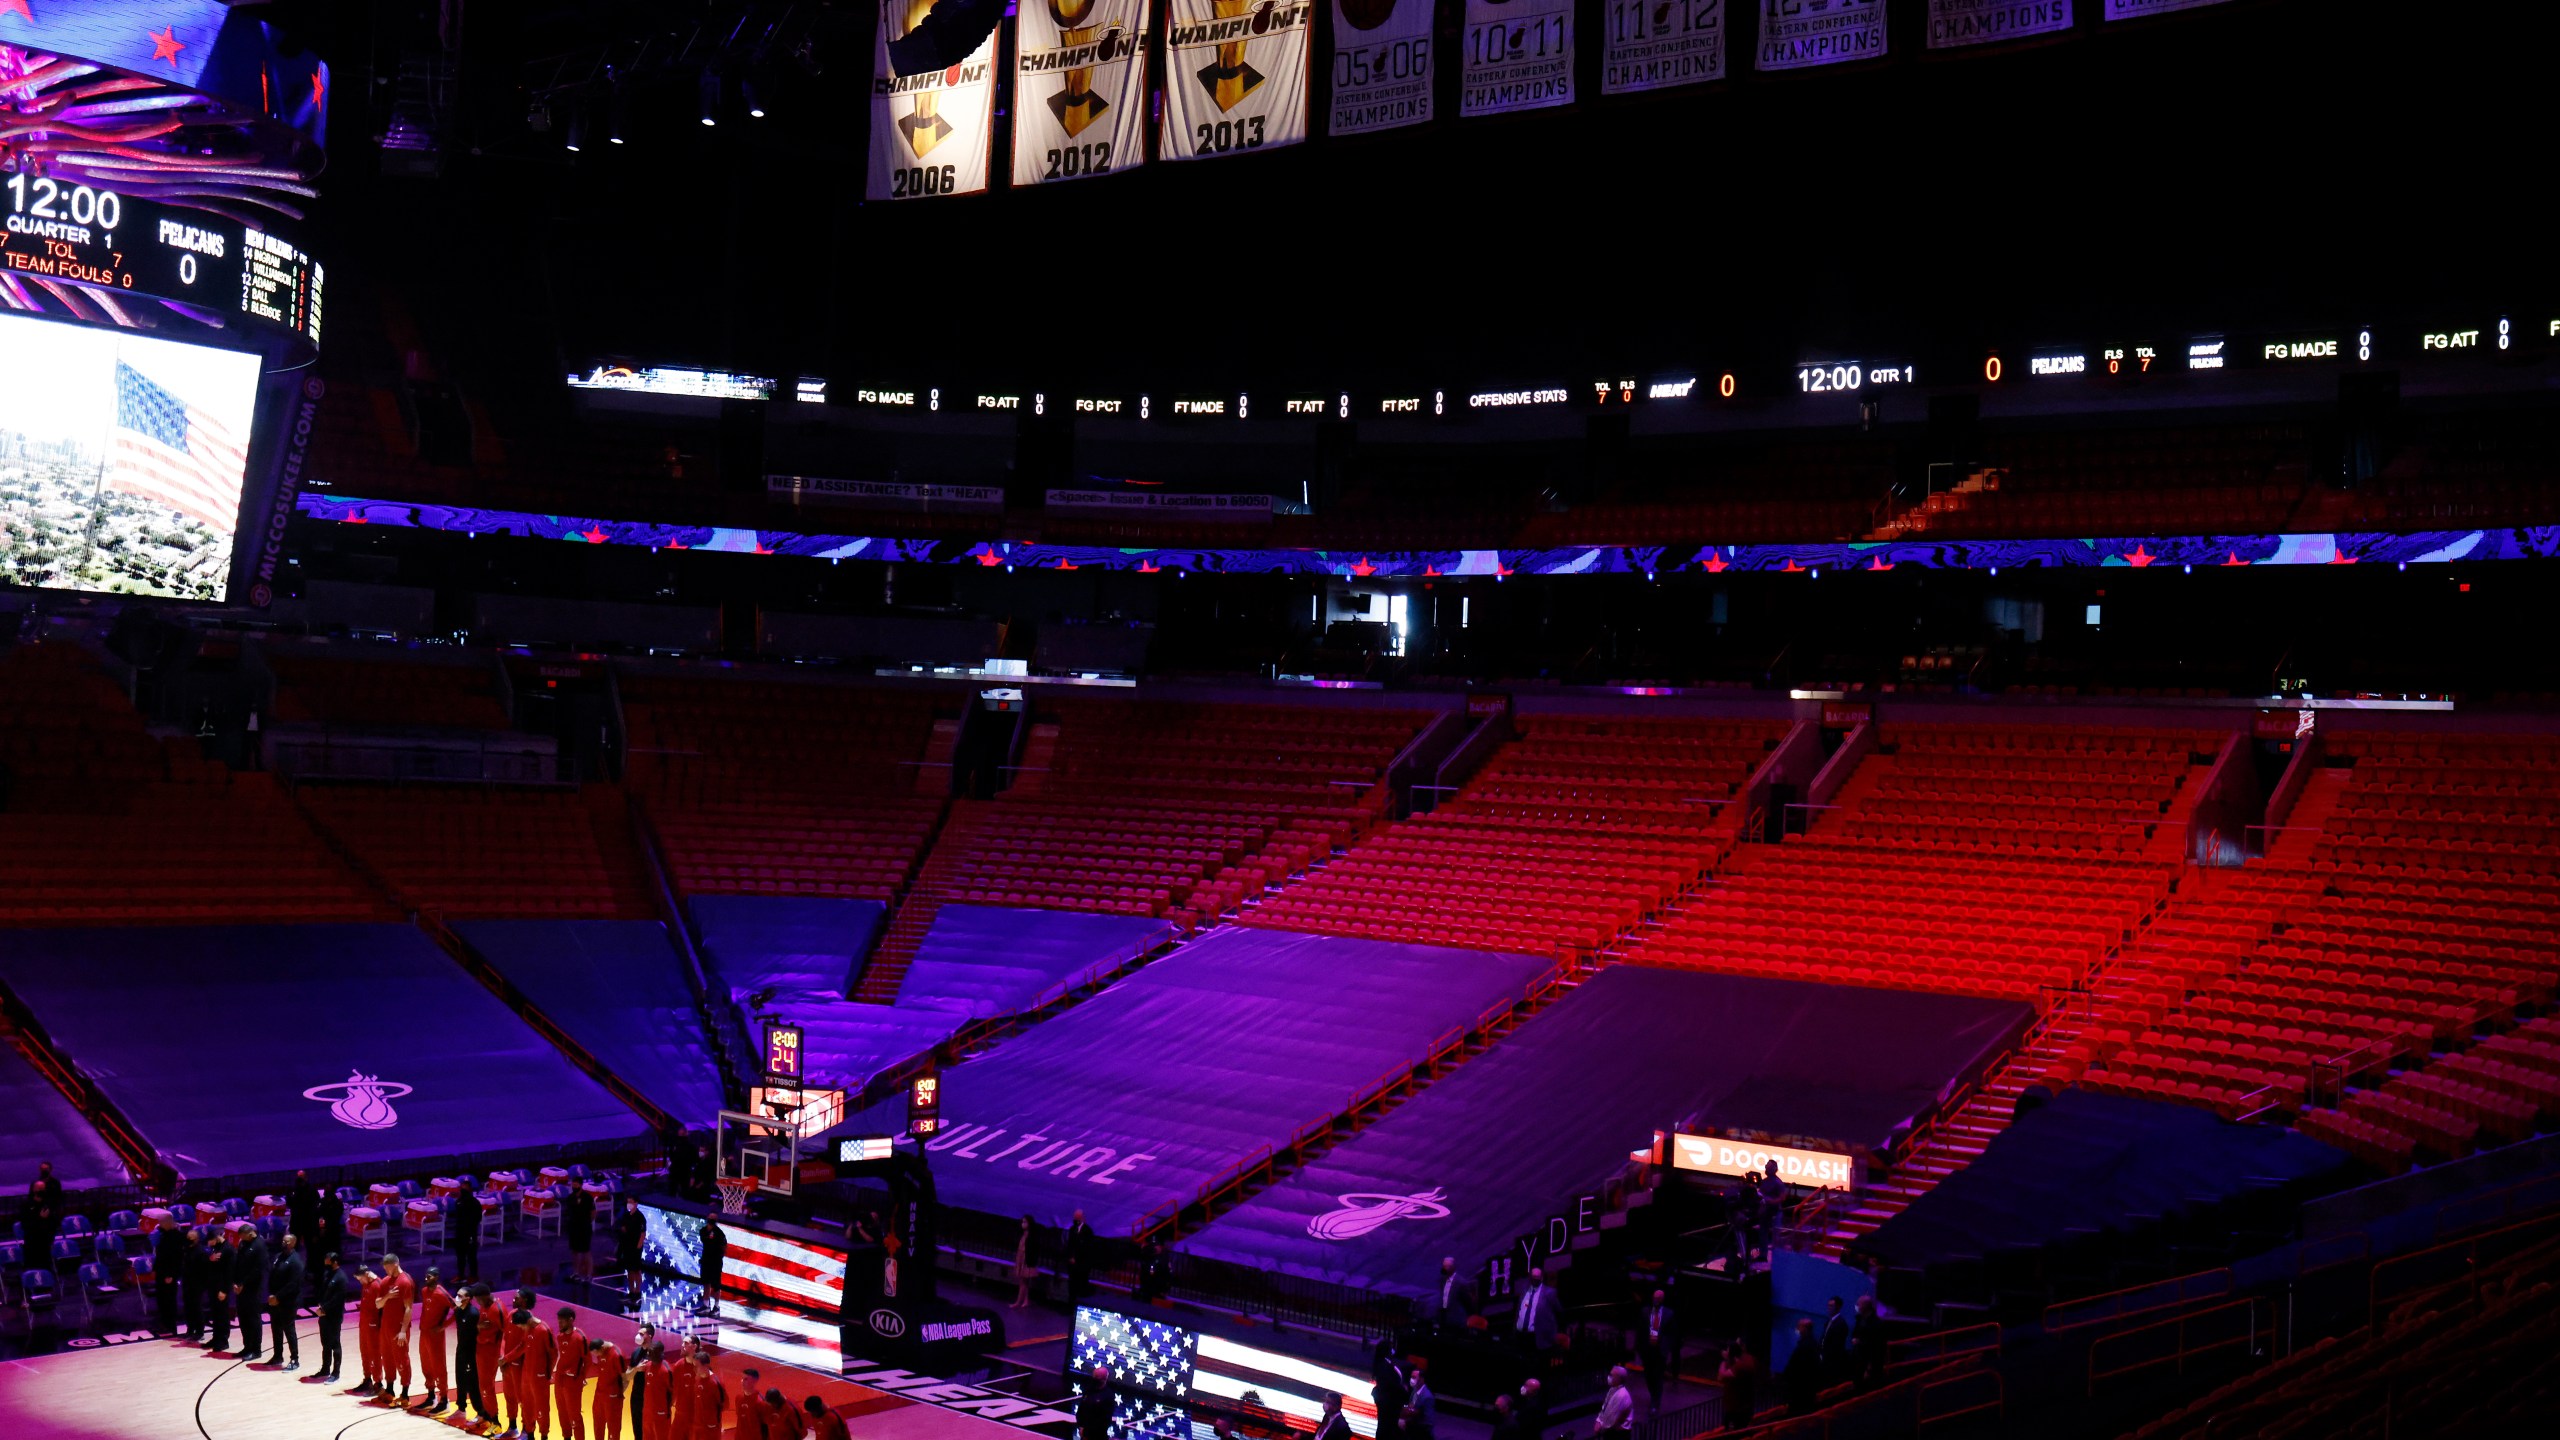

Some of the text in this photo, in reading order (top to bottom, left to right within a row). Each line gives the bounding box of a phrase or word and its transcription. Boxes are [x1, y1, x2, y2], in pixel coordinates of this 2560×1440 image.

[1934, 1, 2064, 39] CHAMPIONS
[1471, 16, 1564, 65] 10 11
[1610, 36, 1719, 60] EASTERN CONFERENCE
[1763, 28, 1881, 62] CHAMPIONS
[1336, 38, 1429, 88] 05 06
[1466, 60, 1567, 83] EASTERN CONFERENCE
[1608, 53, 1718, 85] CHAMPIONS
[1466, 77, 1568, 107] CHAMPIONS
[1336, 98, 1428, 128] CHAMPIONS
[1196, 115, 1266, 155] 2013
[1044, 142, 1111, 180] 2012
[892, 164, 956, 197] 2006
[7, 173, 120, 229] 12:00
[7, 215, 112, 249] QUARTER 1
[159, 218, 225, 257] PELICANS
[45, 240, 77, 260] TOL
[112, 253, 122, 268] 7
[243, 246, 253, 260] 14
[253, 248, 281, 269] INGRAM
[6, 252, 132, 288] TEAM FOULS 0
[179, 253, 197, 285] 0
[242, 272, 252, 287] 12
[252, 275, 277, 293] ADAMS
[243, 285, 249, 299] 2
[251, 287, 270, 304] BALL
[242, 298, 248, 311] 5
[251, 300, 282, 322] BLEDSOE
[2499, 319, 2509, 334] 0
[2360, 332, 2370, 346] 0
[2424, 330, 2479, 350] FG ATT
[2499, 335, 2509, 349] 0
[2105, 347, 2156, 360] FLS TOL
[2265, 341, 2337, 359] FG MADE
[2360, 346, 2370, 360] 0
[1986, 357, 2001, 381] 0
[2031, 355, 2085, 374] PELICANS
[2109, 358, 2150, 373] 0 7
[1595, 380, 1635, 392] TOL FLS
[1721, 374, 1735, 397] 0
[1798, 365, 1913, 391] 12:00 QTR 1
[858, 390, 914, 405] FG MADE
[930, 388, 938, 400] 0
[1435, 391, 1443, 403] 0
[1598, 390, 1631, 404] 7 0
[1650, 378, 1696, 398] HEAT
[930, 400, 938, 411] 0
[978, 396, 1019, 409] FG ATT
[1076, 400, 1121, 412] FG PCT
[1141, 397, 1149, 408] 0
[1174, 401, 1224, 413] FT MADE
[1239, 395, 1247, 406] 0
[1287, 401, 1324, 412] FT ATT
[1340, 395, 1348, 406] 0
[1382, 399, 1420, 412] FT PCT
[1469, 389, 1567, 407] OFFENSIVE STATS
[1035, 403, 1043, 415] 0
[1141, 408, 1149, 419] 0
[1239, 407, 1247, 418] 0
[1340, 406, 1348, 418] 0
[1435, 403, 1443, 415] 0
[258, 402, 317, 582] MICCOSUKEE.COM
[814, 479, 910, 497] ASSISTANCE?
[916, 486, 943, 498] Text
[1160, 494, 1212, 506] Location
[1216, 496, 1227, 507] to
[1230, 495, 1269, 507] 69050
[772, 1031, 797, 1048] 12:00
[771, 1047, 794, 1072] 24
[774, 1077, 797, 1087] TISSOT
[917, 1091, 931, 1105] 24
[1720, 1147, 1848, 1182] DOORDASH
[1489, 1196, 1595, 1297] HYDE
[875, 1313, 899, 1333] KIA
[928, 1318, 991, 1341] NBA League Pass
[843, 1368, 1077, 1427] HEAT
